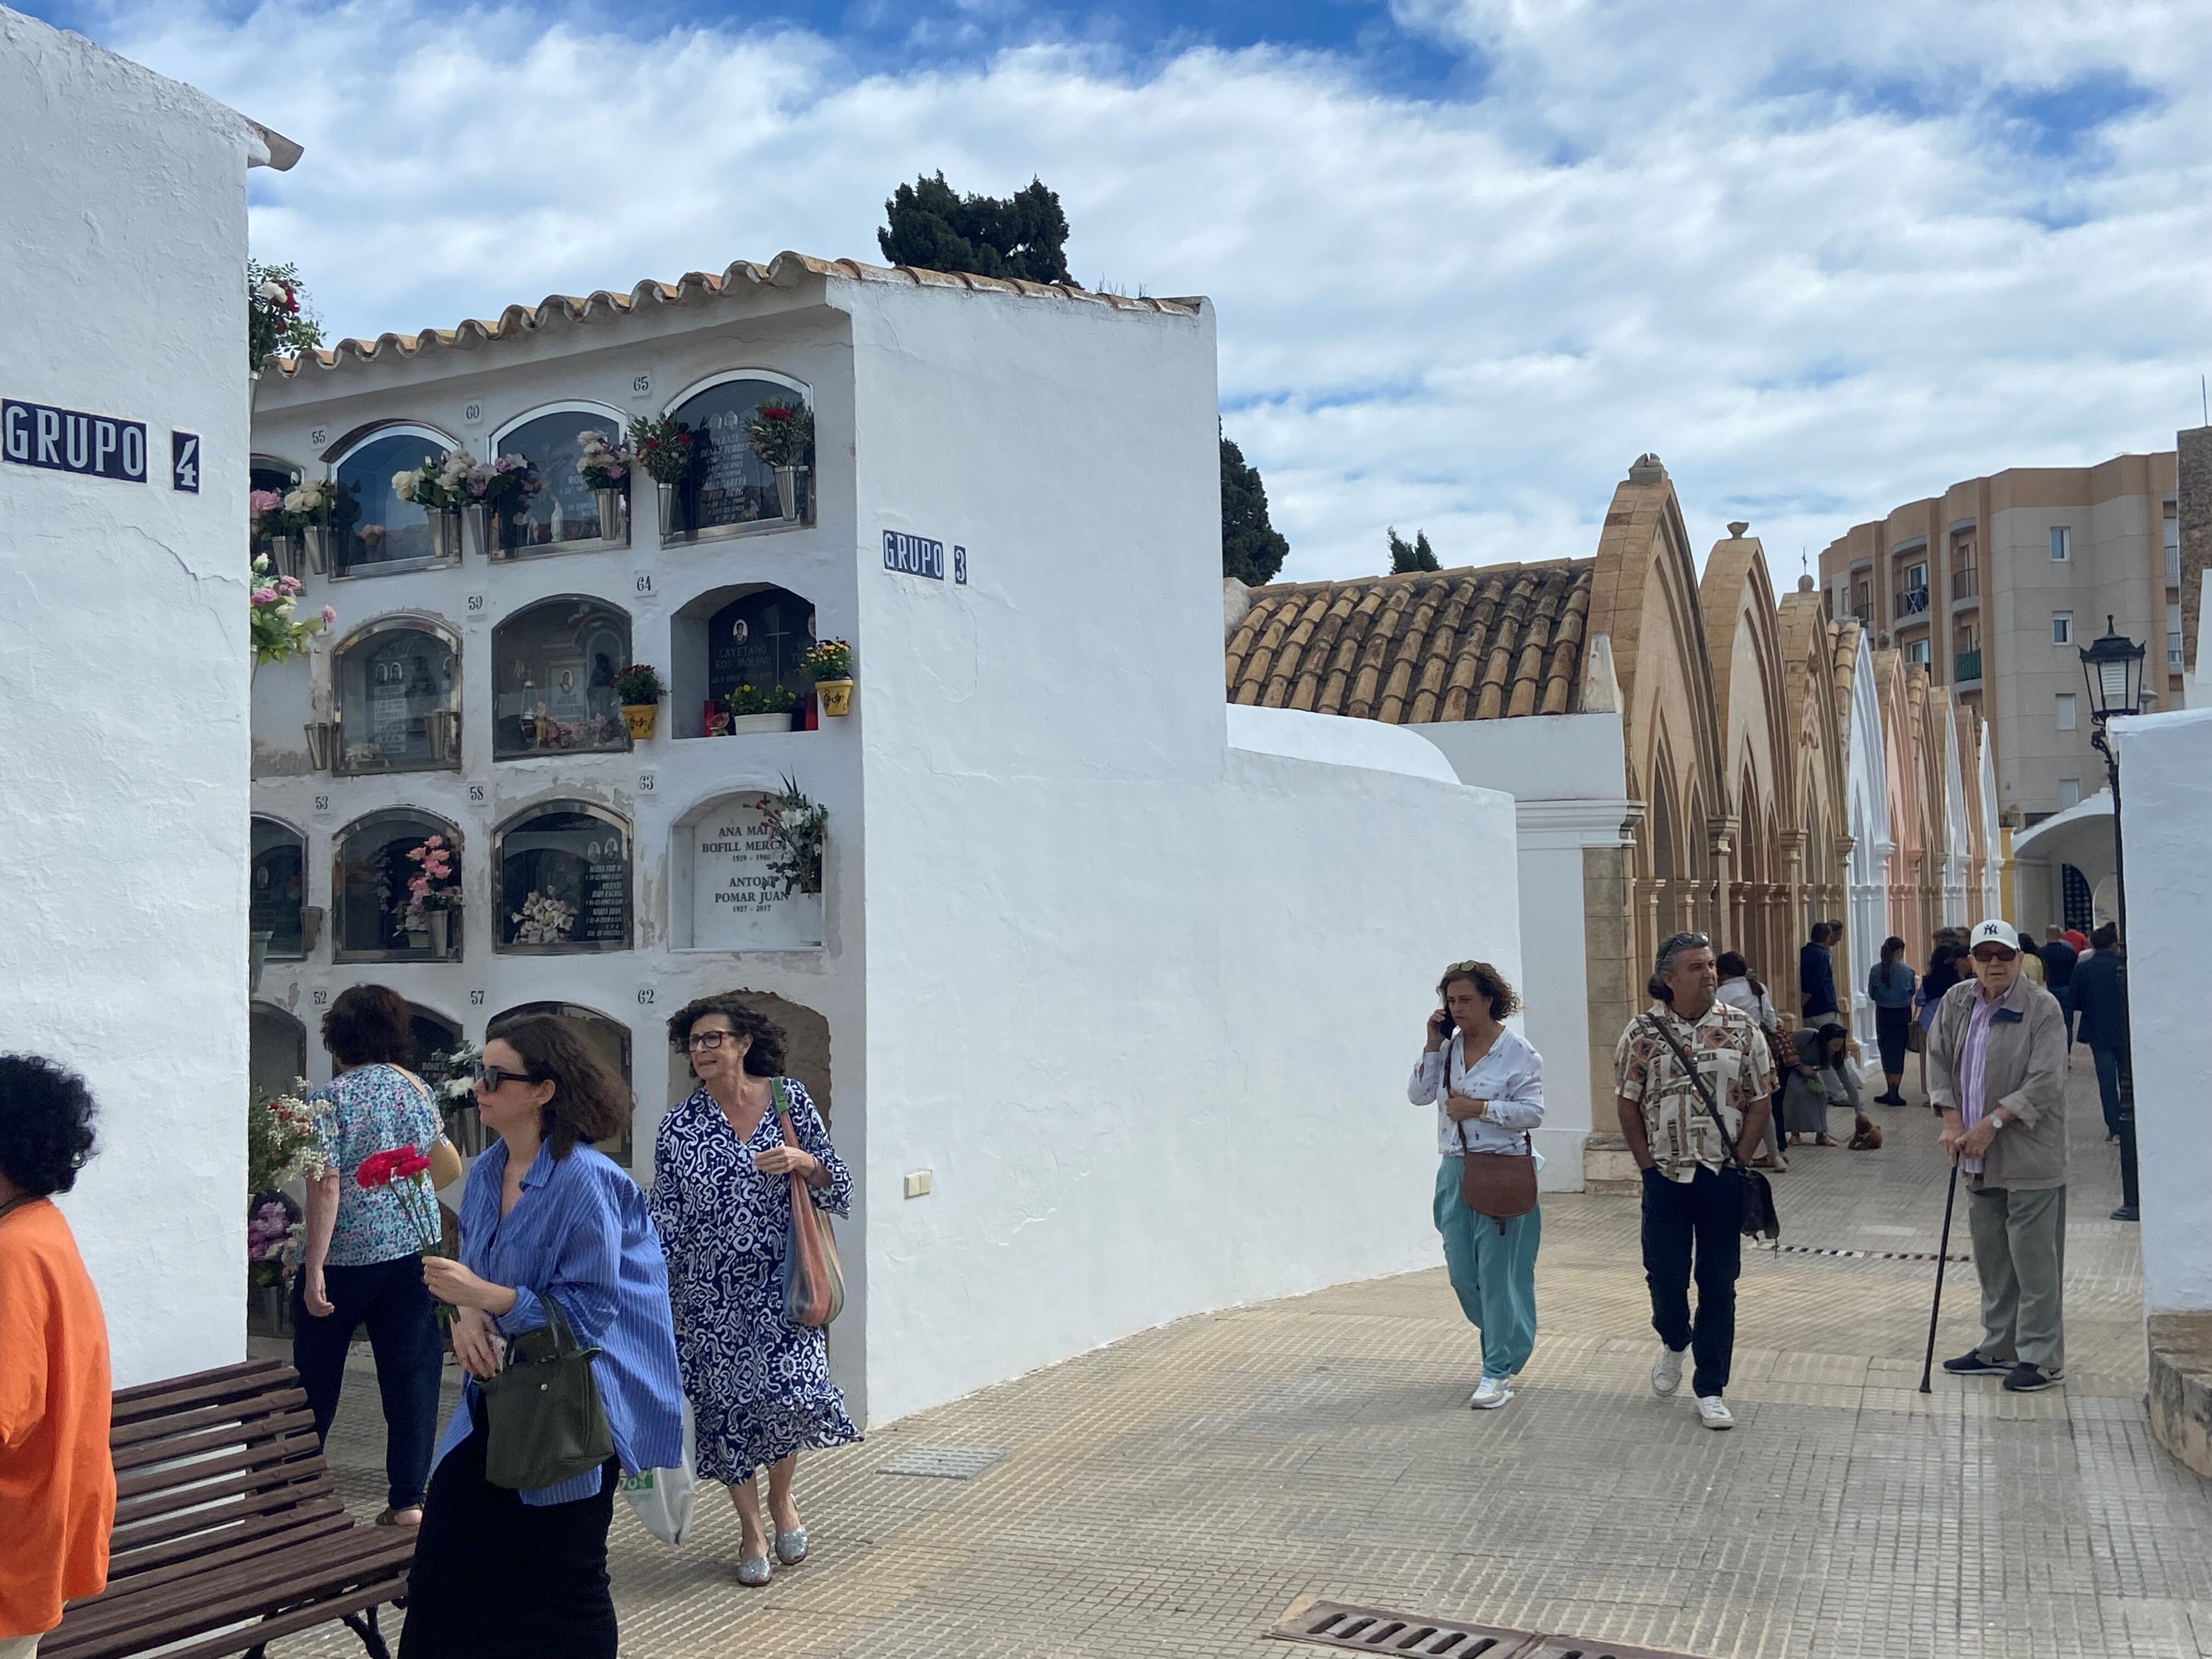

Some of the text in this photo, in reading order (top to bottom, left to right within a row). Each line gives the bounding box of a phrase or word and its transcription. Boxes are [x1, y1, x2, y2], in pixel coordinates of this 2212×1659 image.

[633, 375, 649, 392] 65
[466, 404, 480, 420] 60
[312, 430, 325, 444] 55
[5, 405, 198, 488] GRUPO 4
[884, 533, 966, 582] GRUPO 3
[636, 575, 651, 591] 64
[468, 595, 483, 610] 59
[719, 644, 768, 658] CAYETANO
[639, 774, 654, 790] 63
[470, 785, 483, 800] 58
[315, 795, 329, 810] 53
[718, 826, 742, 837] ANA
[702, 842, 741, 853] BOFILL
[715, 891, 789, 904] POMAR JUAN
[1983, 923, 1998, 935] NY
[313, 991, 327, 1005] 52
[470, 990, 484, 1005] 57
[637, 989, 654, 1005] 62
